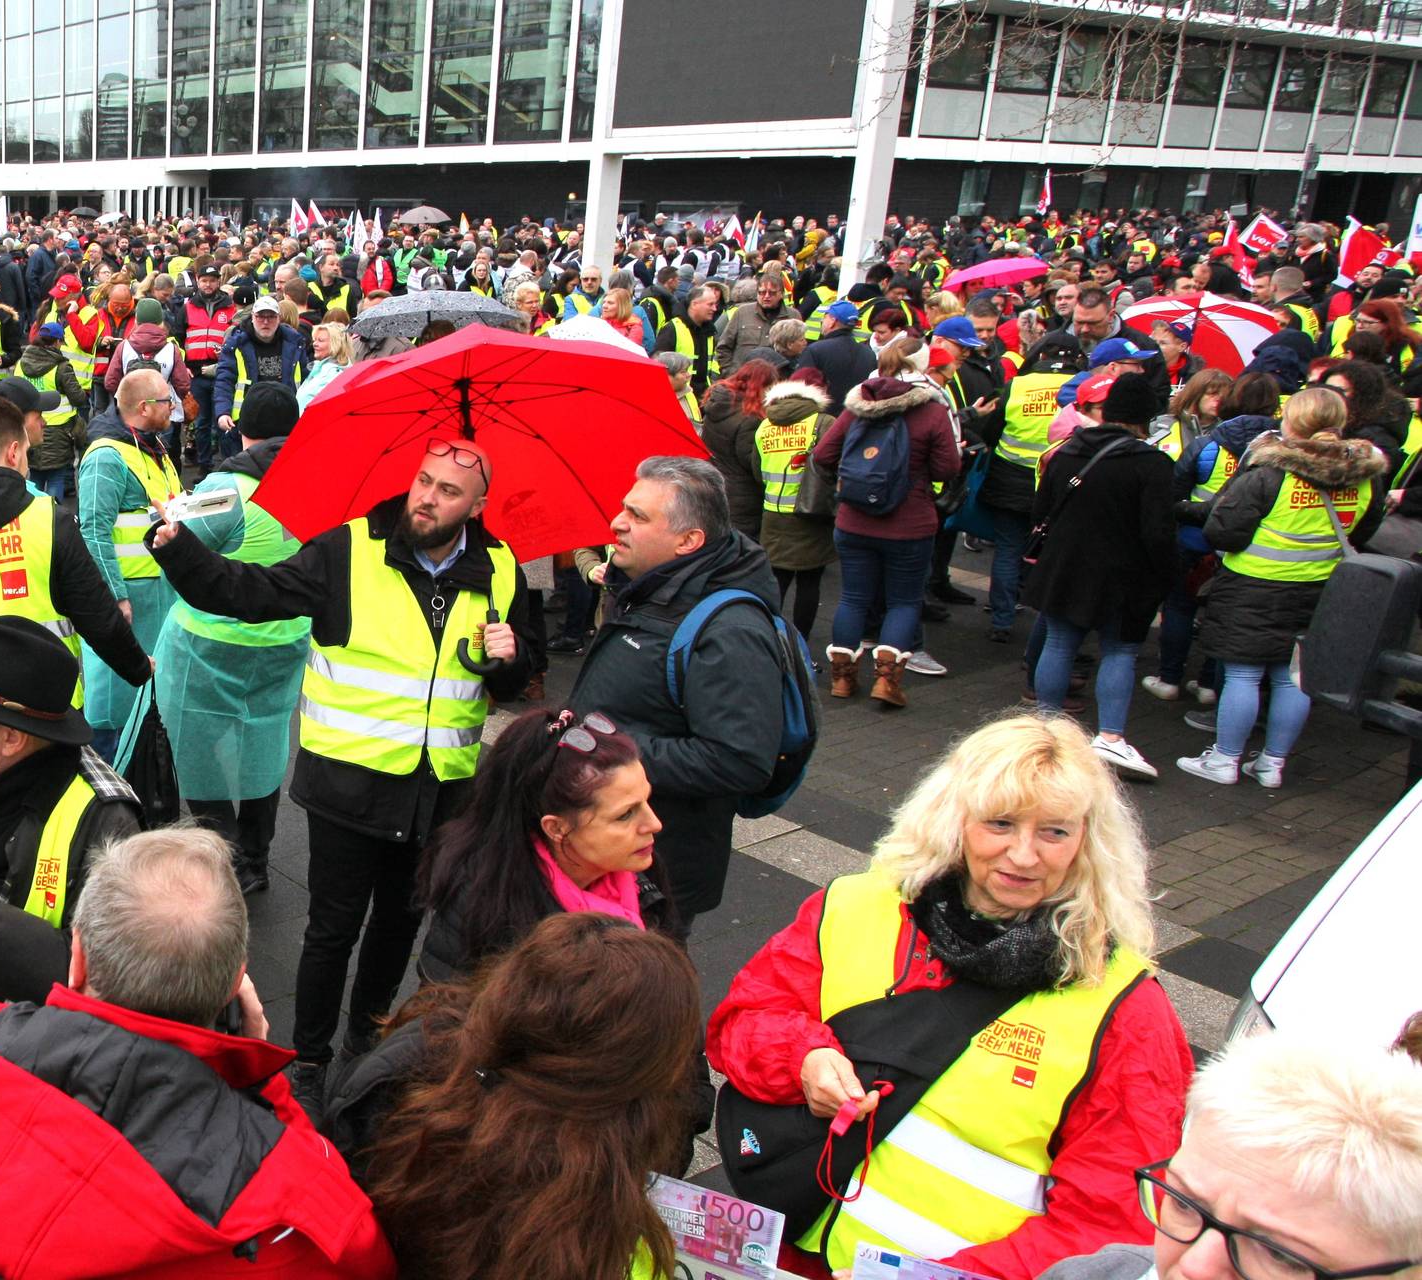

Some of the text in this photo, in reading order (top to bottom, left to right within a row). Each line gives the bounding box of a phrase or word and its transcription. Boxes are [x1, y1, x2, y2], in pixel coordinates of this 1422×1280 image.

[1025, 391, 1058, 402] ZUSAM
[1022, 403, 1047, 413] GEHT
[783, 437, 806, 448] MEHR
[3, 585, 27, 595] ver.di
[978, 1032, 1042, 1060] GEH MEHR
[710, 1195, 765, 1231] 500
[681, 1222, 705, 1236] MEHR
